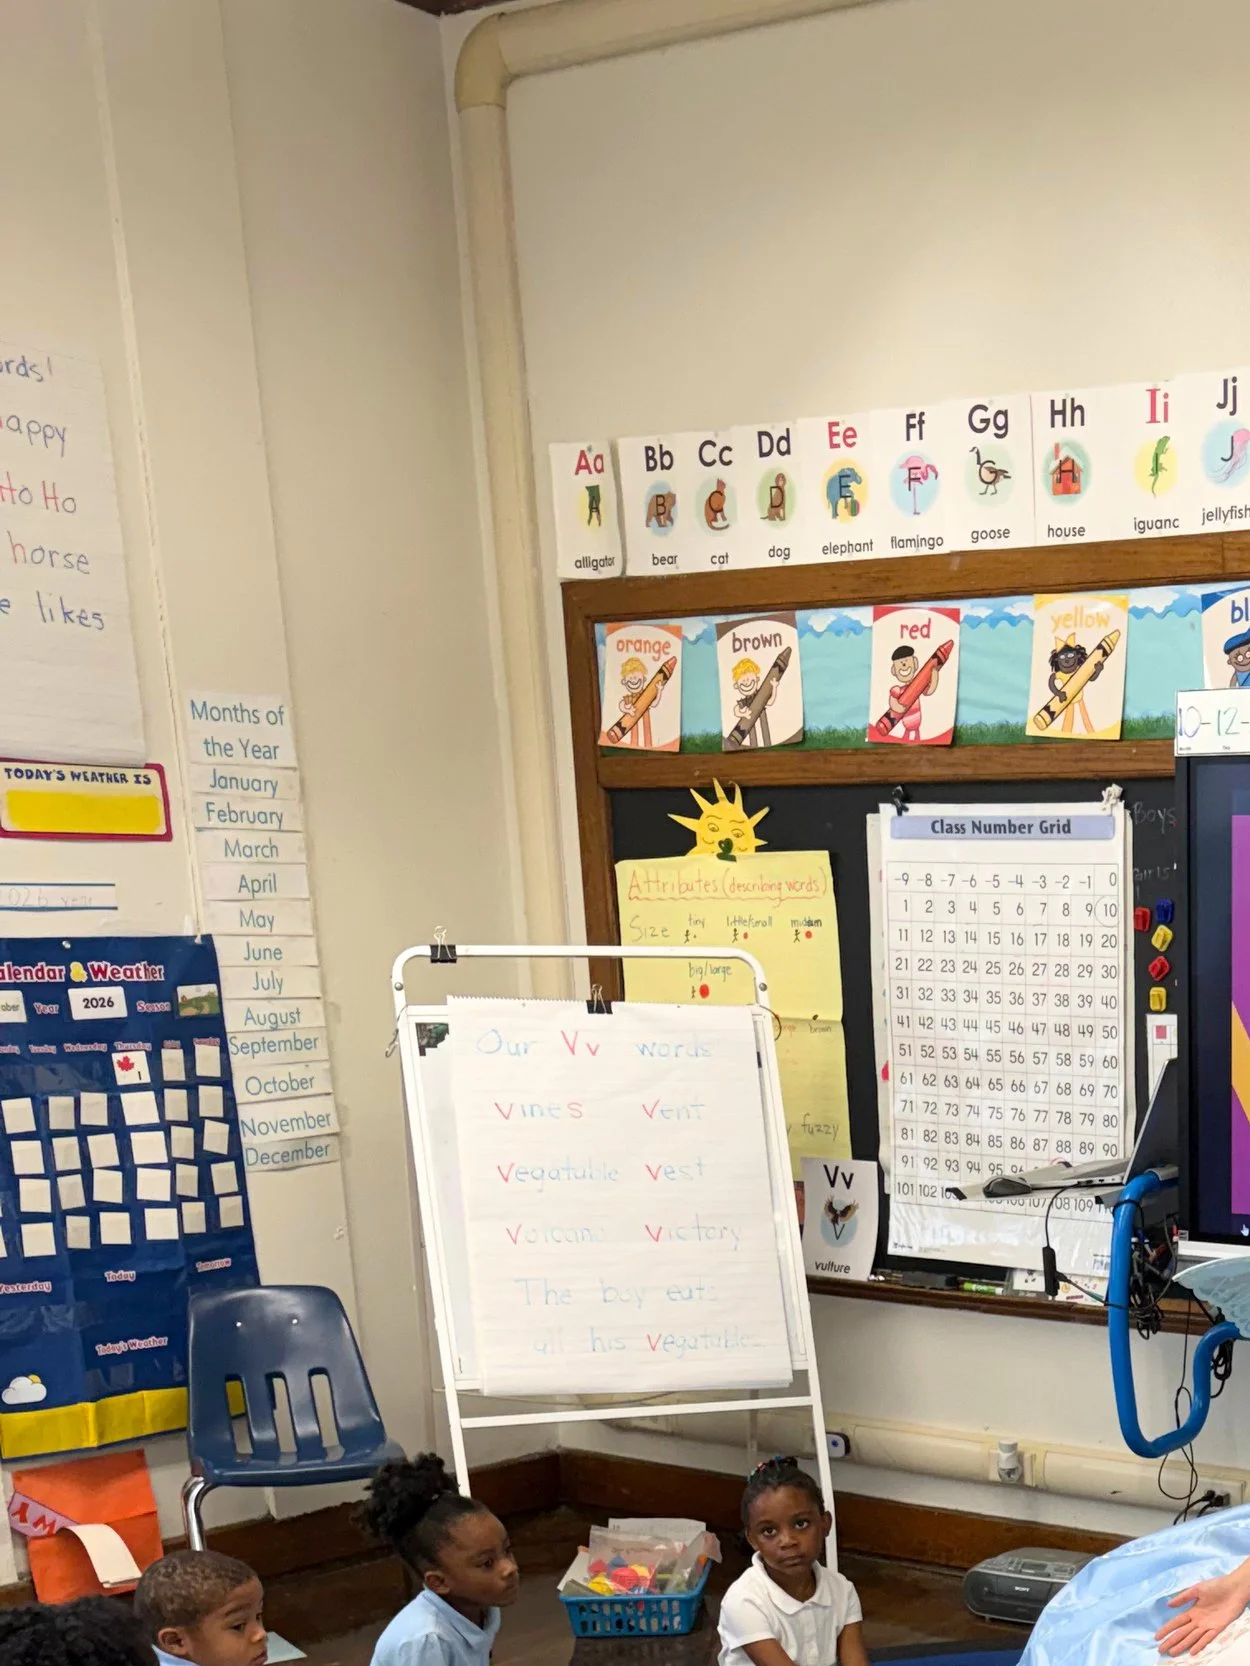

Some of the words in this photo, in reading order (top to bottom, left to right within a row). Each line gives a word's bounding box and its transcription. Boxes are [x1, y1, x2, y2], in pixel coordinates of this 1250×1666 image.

[1145, 388, 1169, 424] Ii
[1216, 376, 1238, 416] Jj
[968, 404, 1009, 440] Gg
[1050, 398, 1085, 428] Hh
[827, 421, 857, 449] Ee
[905, 412, 925, 441] Ff
[699, 440, 733, 467] Cc
[758, 428, 791, 458] Dd
[575, 449, 604, 476] Aa
[645, 445, 674, 472] Bb
[890, 534, 944, 551] flamingo
[971, 526, 1010, 543] goose
[1047, 524, 1086, 539] house
[8, 531, 90, 574] horse
[652, 553, 678, 566] bear
[710, 552, 729, 565] cat
[768, 545, 791, 560] dog
[822, 539, 874, 557] elephant
[575, 555, 615, 571] alligator
[37, 591, 104, 630] likes
[1050, 606, 1110, 632] yellow
[900, 618, 932, 640] red
[616, 637, 671, 662] orange
[732, 629, 782, 653] brown
[191, 700, 259, 724] Months
[266, 706, 284, 726] of
[203, 738, 233, 757] the
[239, 738, 278, 760] Year
[4, 767, 65, 782] TODAY'S
[71, 772, 128, 784] WEATHER
[133, 774, 151, 785] IS
[210, 772, 278, 798] January
[206, 802, 283, 829] February
[931, 820, 966, 834] Class
[972, 820, 1034, 835] Number
[1040, 819, 1071, 834] Grid
[225, 838, 278, 858] March
[238, 873, 277, 894] April
[240, 911, 274, 932] May
[629, 915, 670, 941] Size
[243, 942, 282, 961] June
[0, 962, 65, 982] alendar
[89, 962, 164, 982] Weather
[252, 972, 283, 994] July
[34, 1002, 59, 1015] Year
[83, 997, 114, 1008] 2026
[244, 1008, 301, 1031] August
[230, 1035, 319, 1059] September
[476, 1029, 533, 1056] Our
[561, 1030, 599, 1057] Vv
[636, 1036, 712, 1058] words
[246, 1075, 314, 1095] October
[900, 1072, 913, 1085] 61
[922, 1073, 936, 1086] 62
[944, 1075, 959, 1088] 63
[965, 1076, 980, 1089] 64
[988, 1078, 1003, 1091] 65
[1011, 1079, 1026, 1092] 66
[1034, 1081, 1048, 1094] 67
[1056, 1082, 1071, 1095] 68
[1080, 1084, 1094, 1097] 69
[1103, 1085, 1118, 1098] 70
[241, 1111, 331, 1137] November
[801, 1114, 839, 1141] fuzzy
[246, 1143, 329, 1166] December
[824, 1164, 854, 1190] Vv
[105, 1270, 135, 1282] Today
[815, 1261, 850, 1274] vulture
